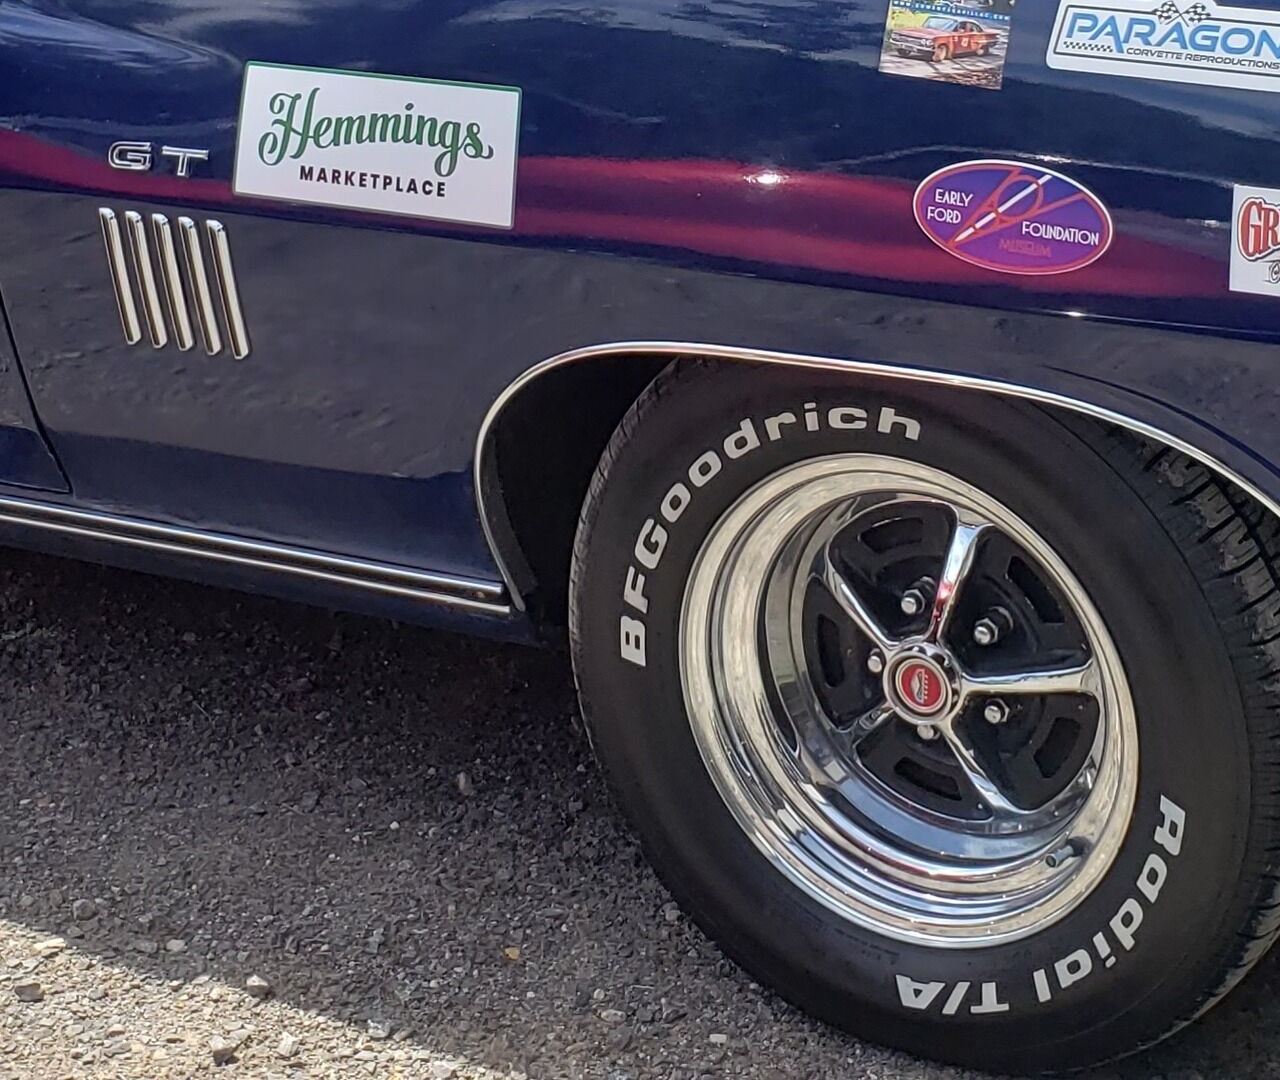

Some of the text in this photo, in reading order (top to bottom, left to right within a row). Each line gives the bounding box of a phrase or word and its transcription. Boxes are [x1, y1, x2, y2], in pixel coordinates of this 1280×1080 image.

[1126, 46, 1280, 71] CORVETTE REPRODUCTIONS
[258, 87, 494, 178] Hemmings
[107, 141, 209, 177] GT
[299, 165, 447, 198] MARKETPLACE
[935, 188, 974, 207] EARLY
[927, 206, 961, 224] FORD
[1022, 221, 1100, 246] FOUNDATION
[619, 401, 921, 668] BFGoodrich
[895, 793, 1187, 1016] Radial T/A
